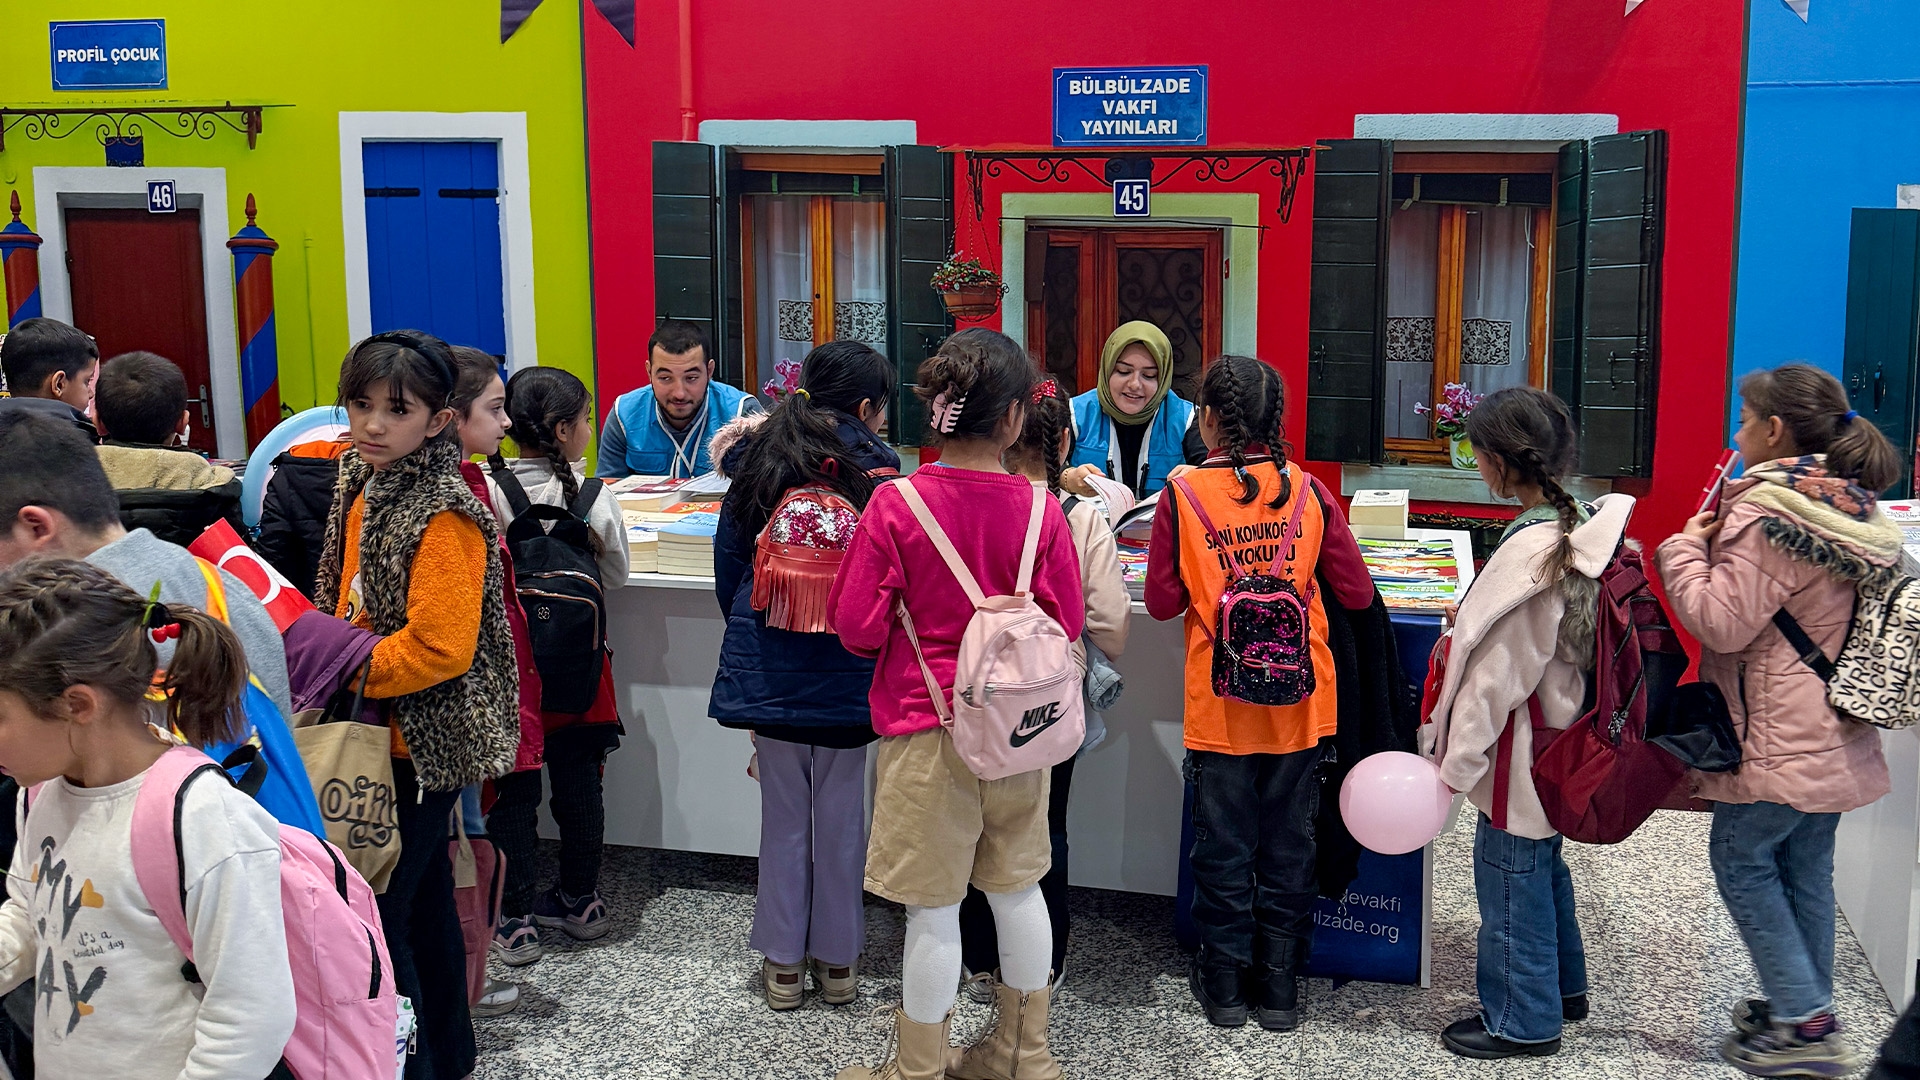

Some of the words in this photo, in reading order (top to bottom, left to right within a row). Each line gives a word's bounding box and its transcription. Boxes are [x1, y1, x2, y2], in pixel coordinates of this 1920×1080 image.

[57, 45, 108, 63] PROFİL
[110, 47, 160, 65] ÇOCUK
[1069, 75, 1191, 95] BÜLBÜLZADE
[1102, 99, 1157, 115] VAKFI
[1080, 119, 1178, 135] YAYINLARI
[151, 184, 172, 208] 46
[1119, 184, 1144, 211] 45
[1235, 516, 1303, 545] KONUKOĞU
[1018, 700, 1060, 731] NIKE
